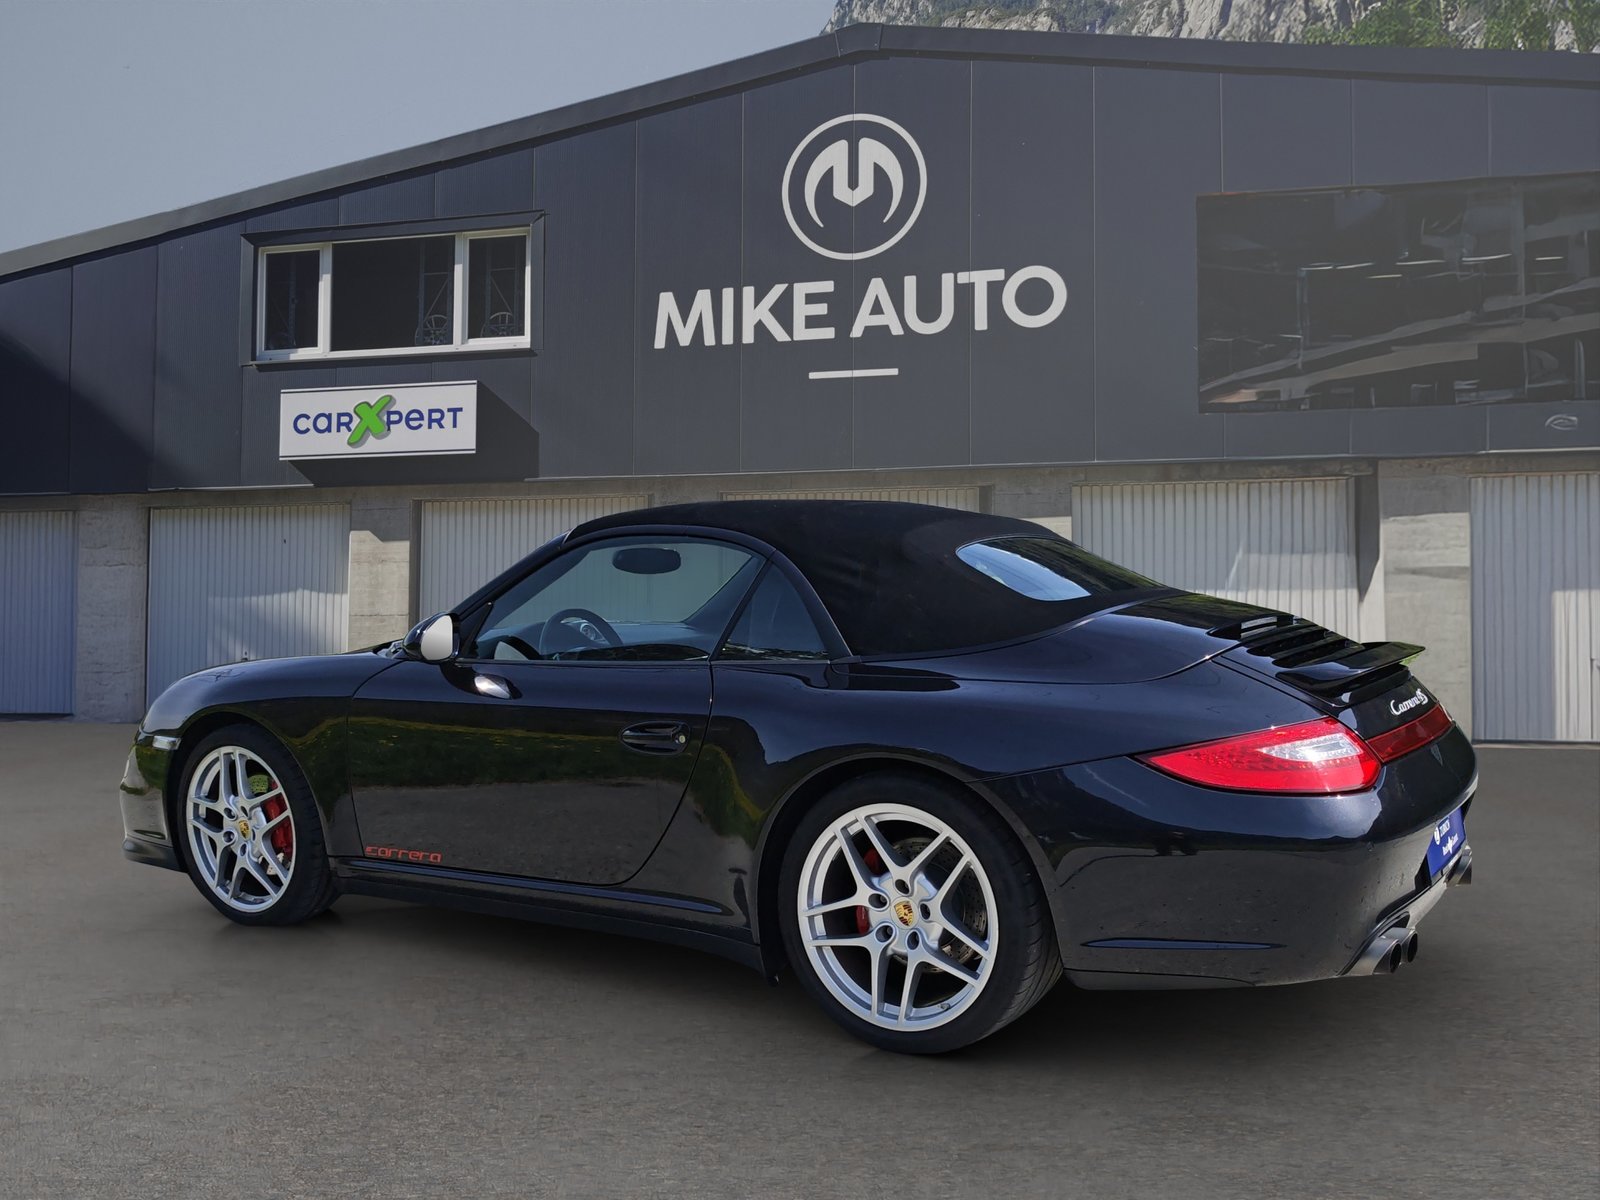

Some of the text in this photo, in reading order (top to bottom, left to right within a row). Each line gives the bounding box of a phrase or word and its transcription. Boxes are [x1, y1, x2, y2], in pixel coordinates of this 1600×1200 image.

[654, 265, 1067, 349] MIKE AUTO
[365, 846, 442, 863] carrera
